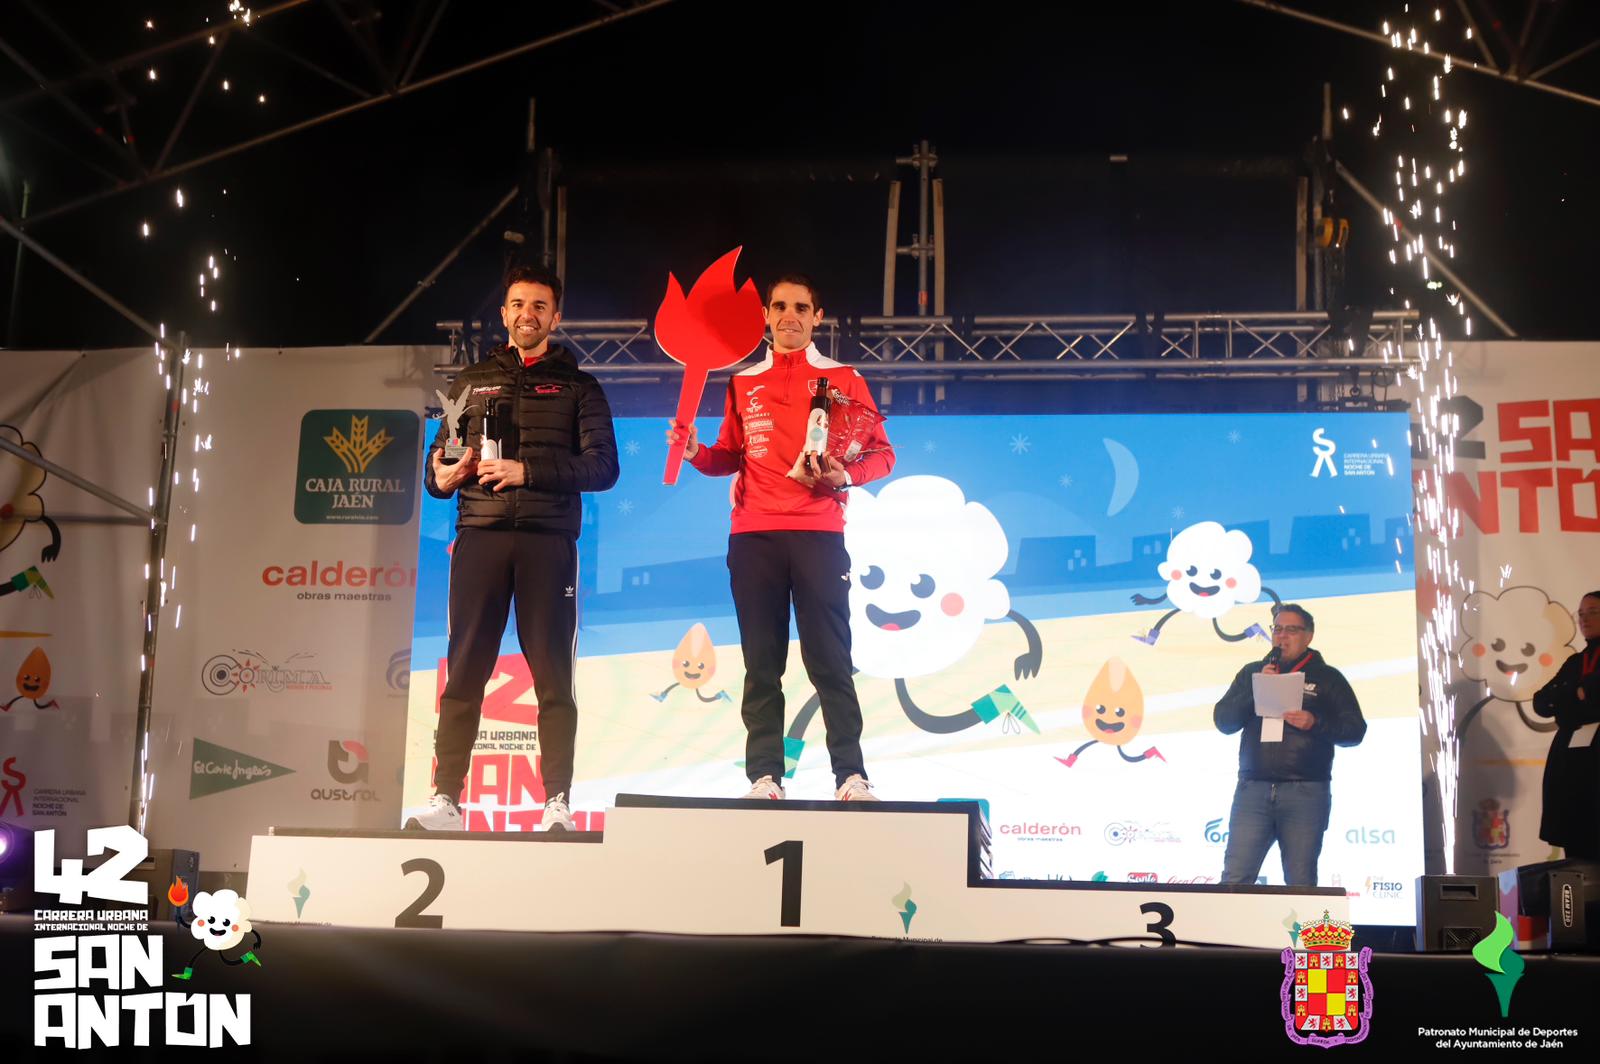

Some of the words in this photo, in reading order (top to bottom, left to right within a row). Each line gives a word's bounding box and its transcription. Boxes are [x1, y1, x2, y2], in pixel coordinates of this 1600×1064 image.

[305, 478, 344, 493] CAJA
[348, 478, 405, 493] RURAL
[332, 492, 375, 508] JAÉN
[296, 591, 331, 601] obras
[334, 592, 392, 601] maestras
[490, 730, 537, 741] URBANA
[499, 743, 524, 751] NOCHE
[205, 762, 231, 776] Corte
[310, 788, 382, 801] austral
[999, 822, 1082, 836] calderón
[1345, 826, 1396, 844] alsa
[764, 840, 804, 928] 1
[1373, 881, 1403, 891] FISIO
[394, 858, 445, 929] 2
[1139, 902, 1177, 948] 3
